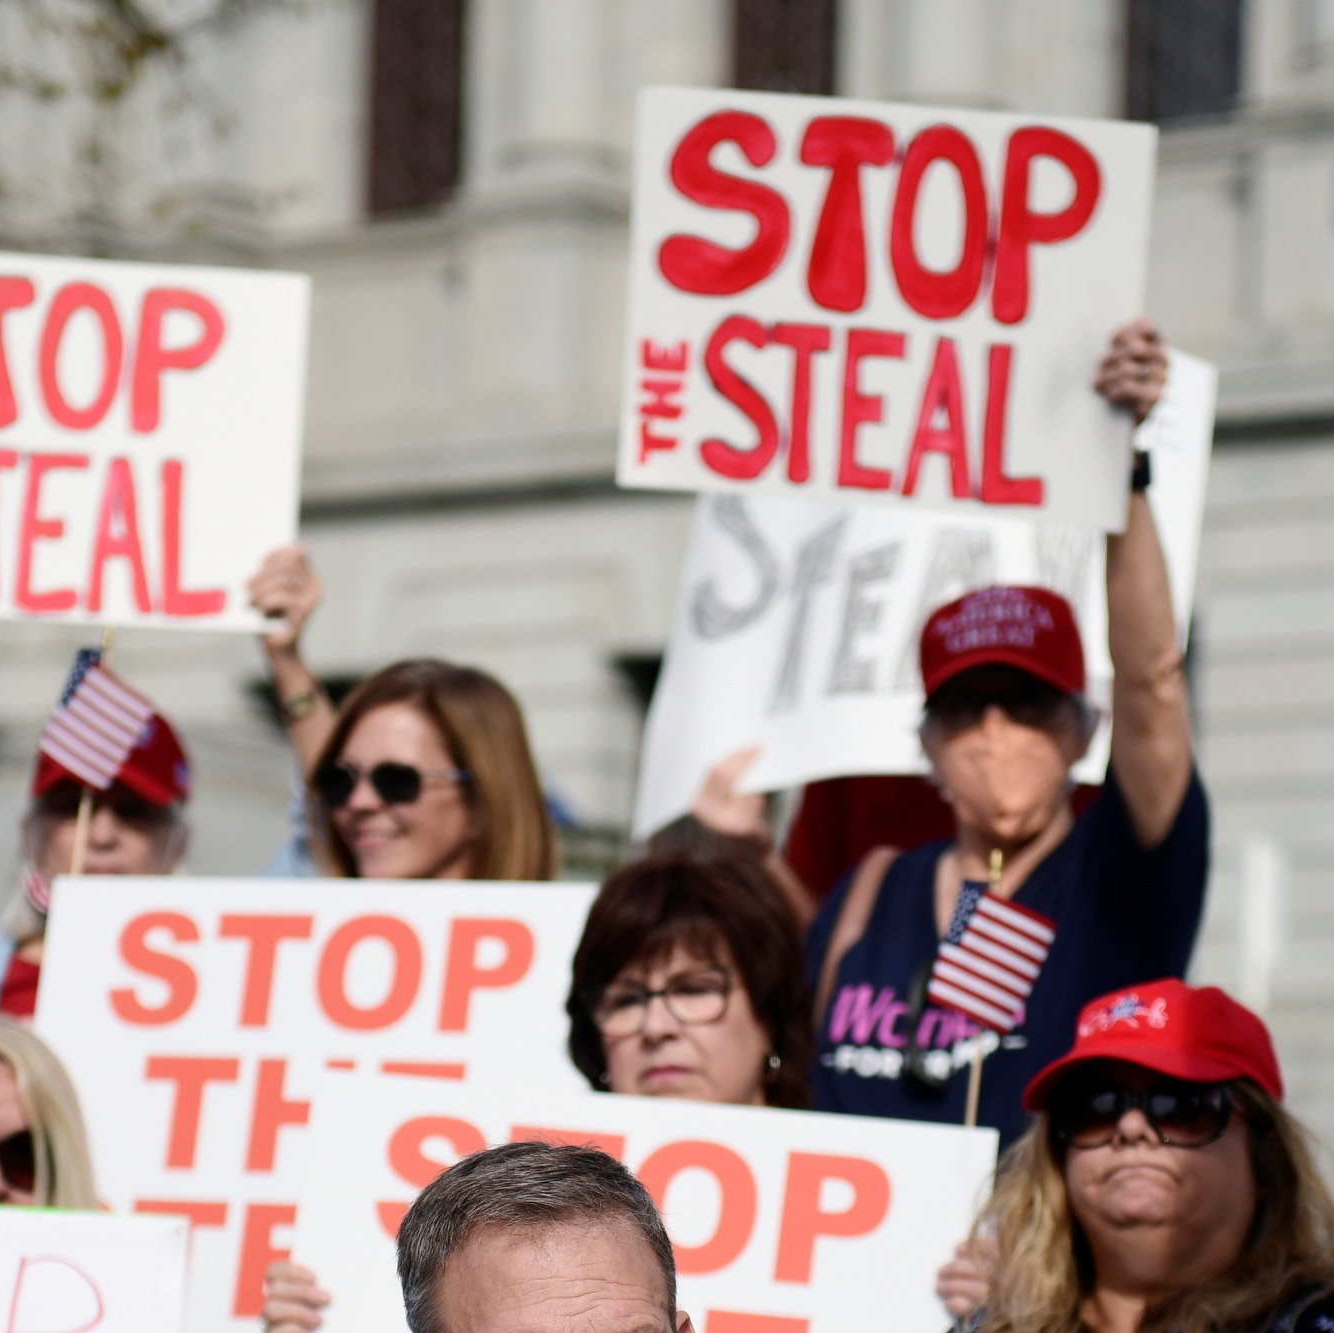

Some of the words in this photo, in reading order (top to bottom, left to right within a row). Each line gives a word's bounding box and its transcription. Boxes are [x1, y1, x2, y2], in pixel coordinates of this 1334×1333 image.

[657, 109, 1104, 326] STOP
[635, 338, 692, 466] THE
[699, 314, 1048, 507] STEAL
[109, 911, 535, 1033] STOP
